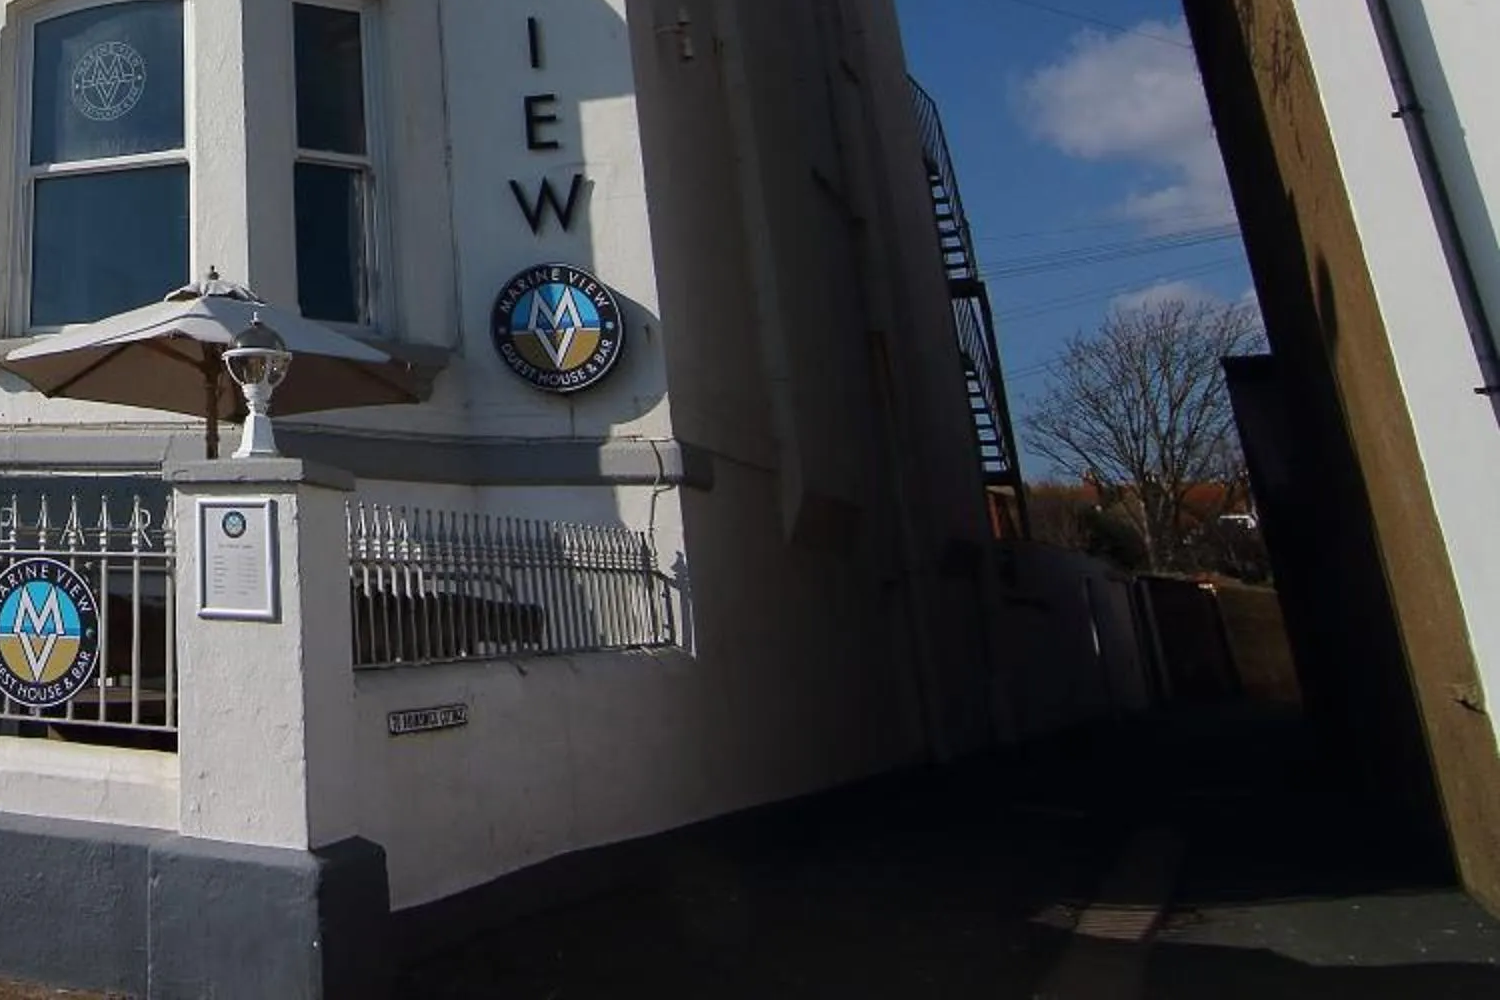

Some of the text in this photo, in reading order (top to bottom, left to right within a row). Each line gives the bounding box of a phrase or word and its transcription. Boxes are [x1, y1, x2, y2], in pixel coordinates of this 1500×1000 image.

[501, 268, 610, 313] MARINE VIEW
[501, 343, 537, 377] GUEST
[537, 369, 587, 386] HOUSE
[594, 339, 613, 363] BAR
[56, 568, 93, 612] VIEW
[17, 682, 63, 702] HOUSE
[71, 650, 92, 678] BAR
